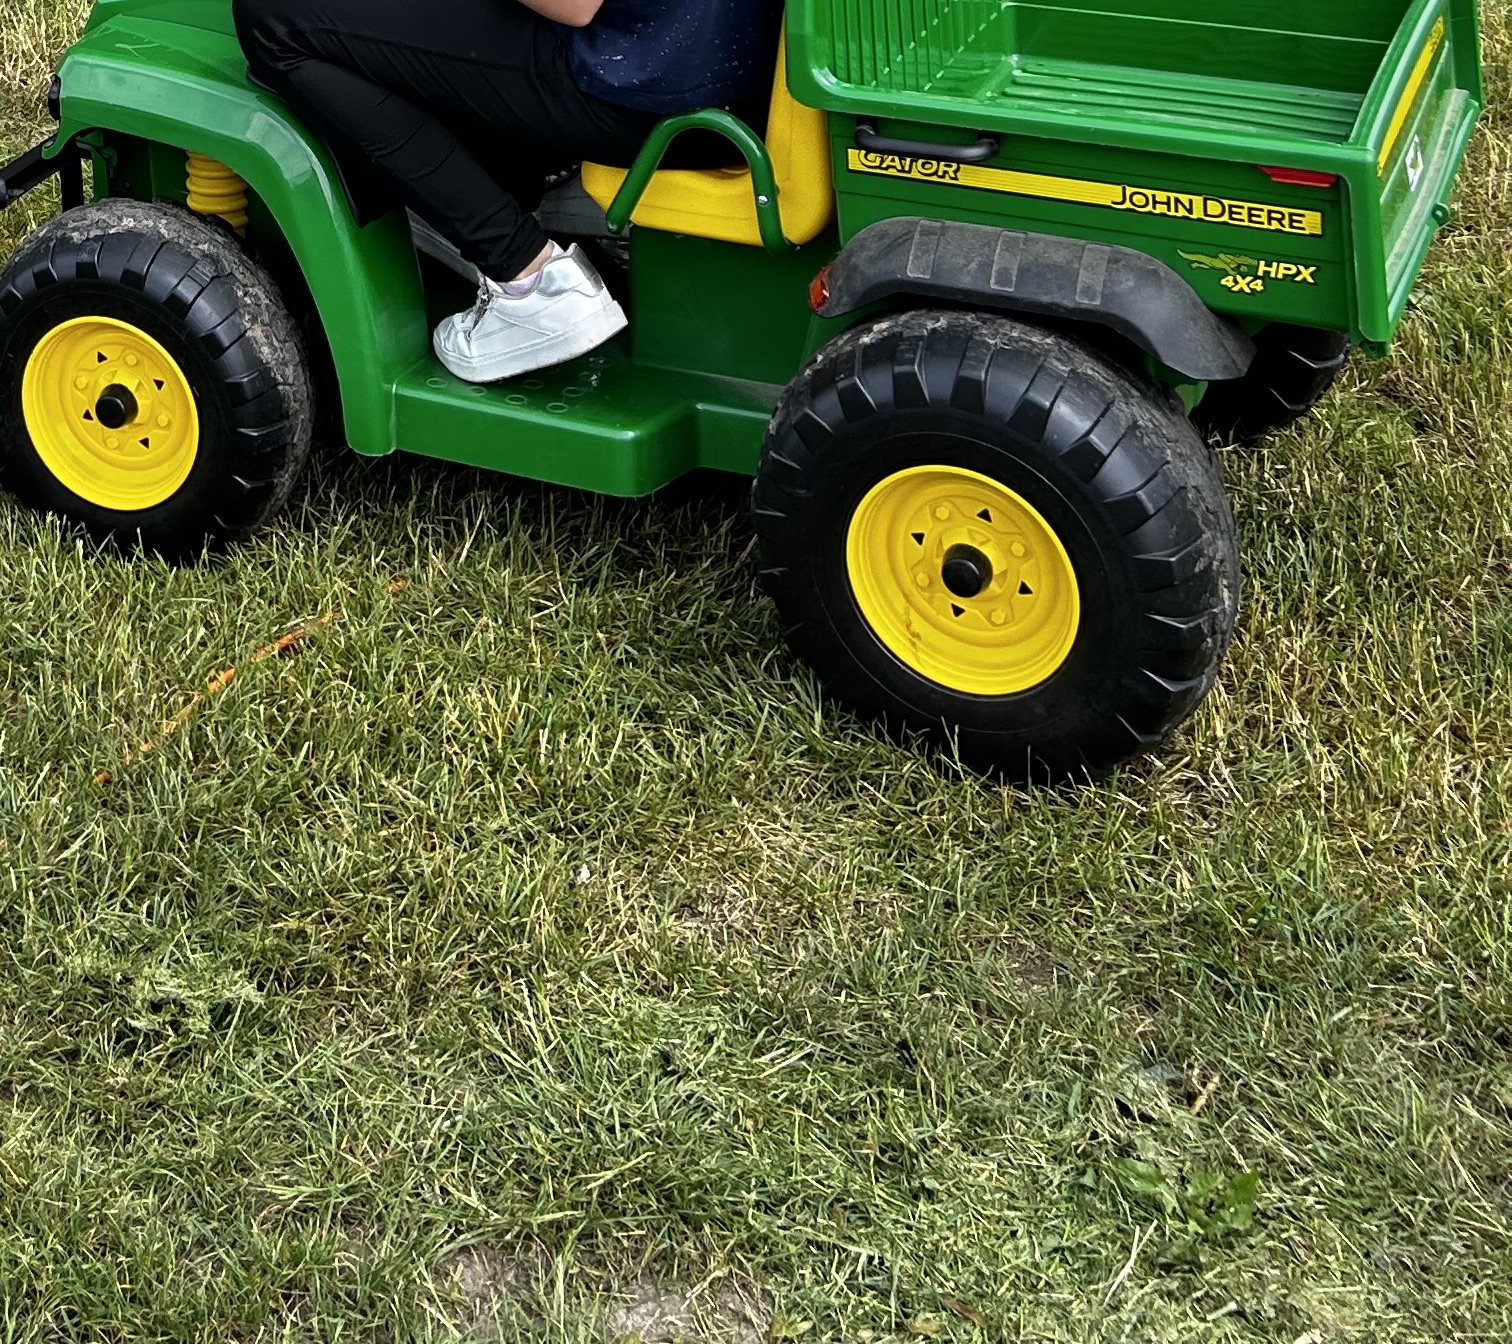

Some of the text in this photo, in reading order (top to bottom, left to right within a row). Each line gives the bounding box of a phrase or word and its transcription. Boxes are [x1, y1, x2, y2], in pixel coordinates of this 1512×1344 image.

[858, 149, 959, 180] GATOR
[1111, 185, 1307, 231] JOHN DEERE
[1219, 274, 1266, 294] 4X4
[1256, 260, 1318, 284] HPX
